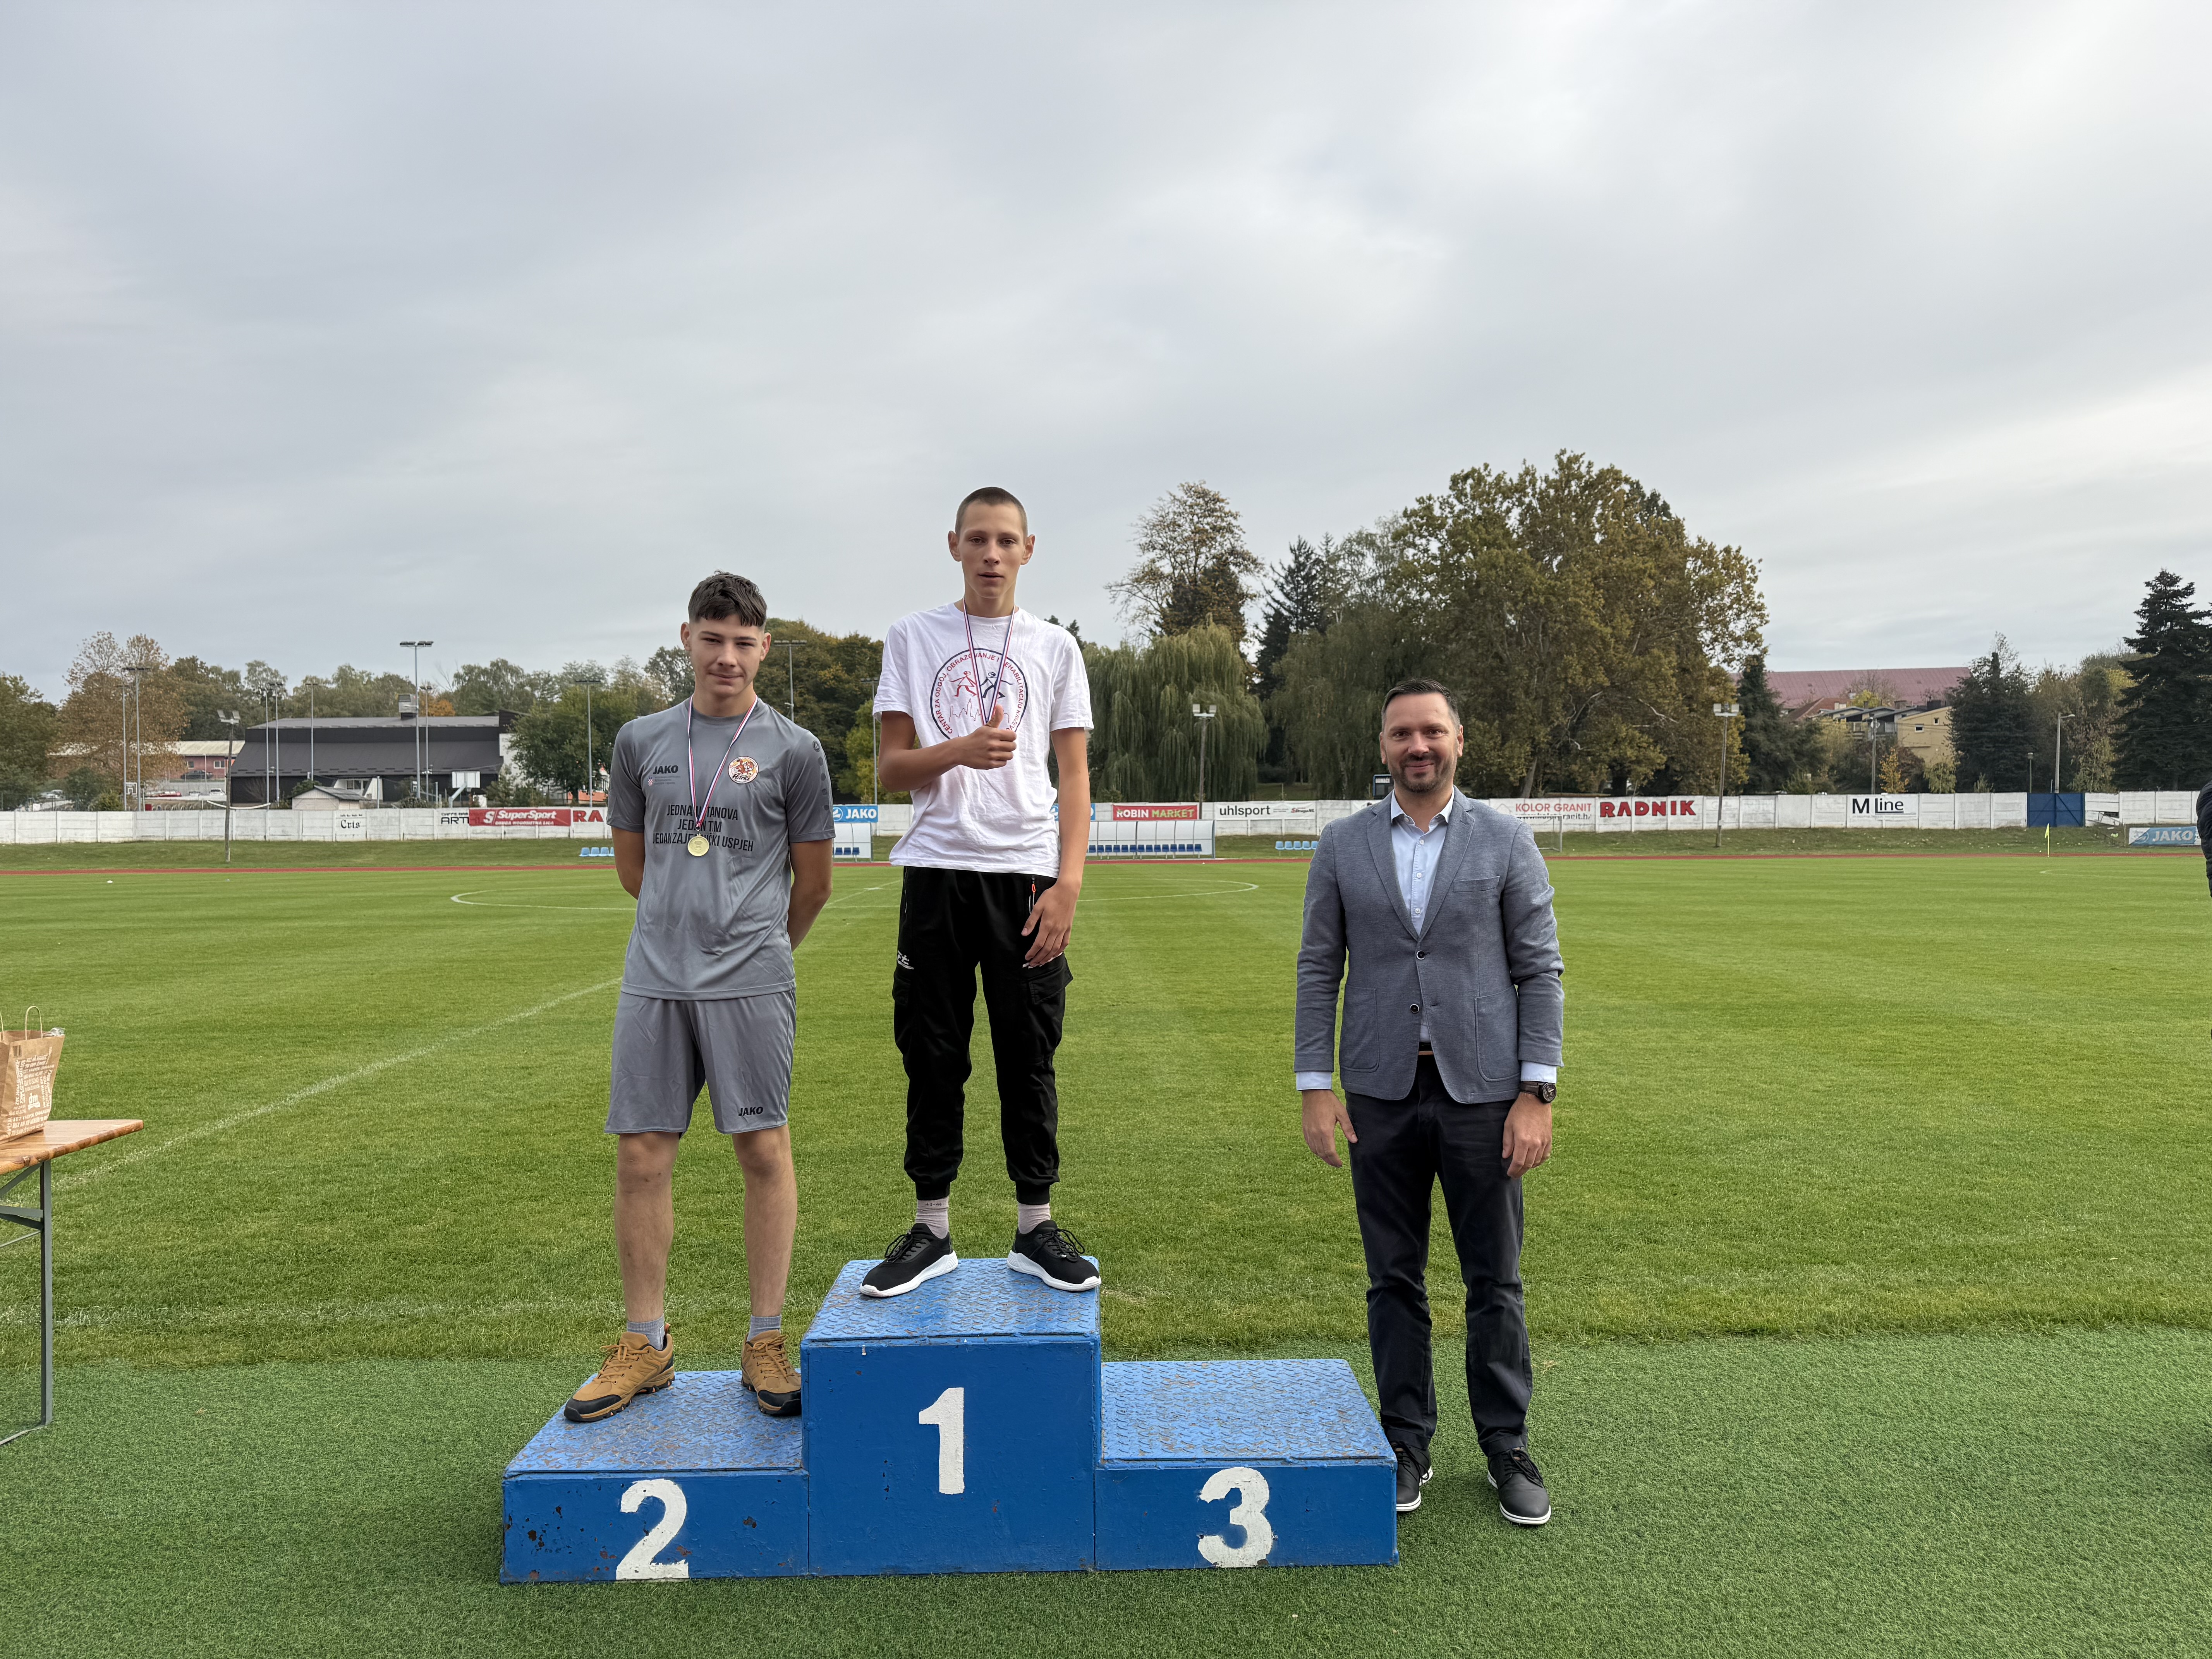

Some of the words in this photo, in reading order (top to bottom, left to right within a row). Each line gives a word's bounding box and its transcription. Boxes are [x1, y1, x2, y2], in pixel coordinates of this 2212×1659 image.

[935, 673, 948, 697] ODGOJ,
[1004, 661, 1024, 709] EHABILITACIJU
[935, 699, 940, 708] ZA
[936, 709, 953, 734] CENTAR
[653, 765, 678, 775] JAKO
[667, 804, 693, 816] JEDNA
[1219, 805, 1271, 817] uhlsport
[1515, 803, 1551, 812] KOLOR
[1553, 803, 1592, 812] GRANIT
[1600, 800, 1696, 817] RADNIK
[1852, 798, 1870, 814] M
[497, 810, 556, 821] SuperSport
[845, 808, 877, 819] JAKO
[1116, 809, 1149, 818] ROBIN
[1152, 809, 1194, 818] MARKET
[708, 820, 722, 832] TIM
[2152, 830, 2194, 842] JAKO
[653, 833, 672, 844] JEDAN
[722, 836, 754, 852] USPJEH
[738, 1106, 763, 1116] JAKO
[919, 1387, 965, 1494] 1
[1197, 1466, 1274, 1568] 3
[615, 1478, 689, 1580] 2
